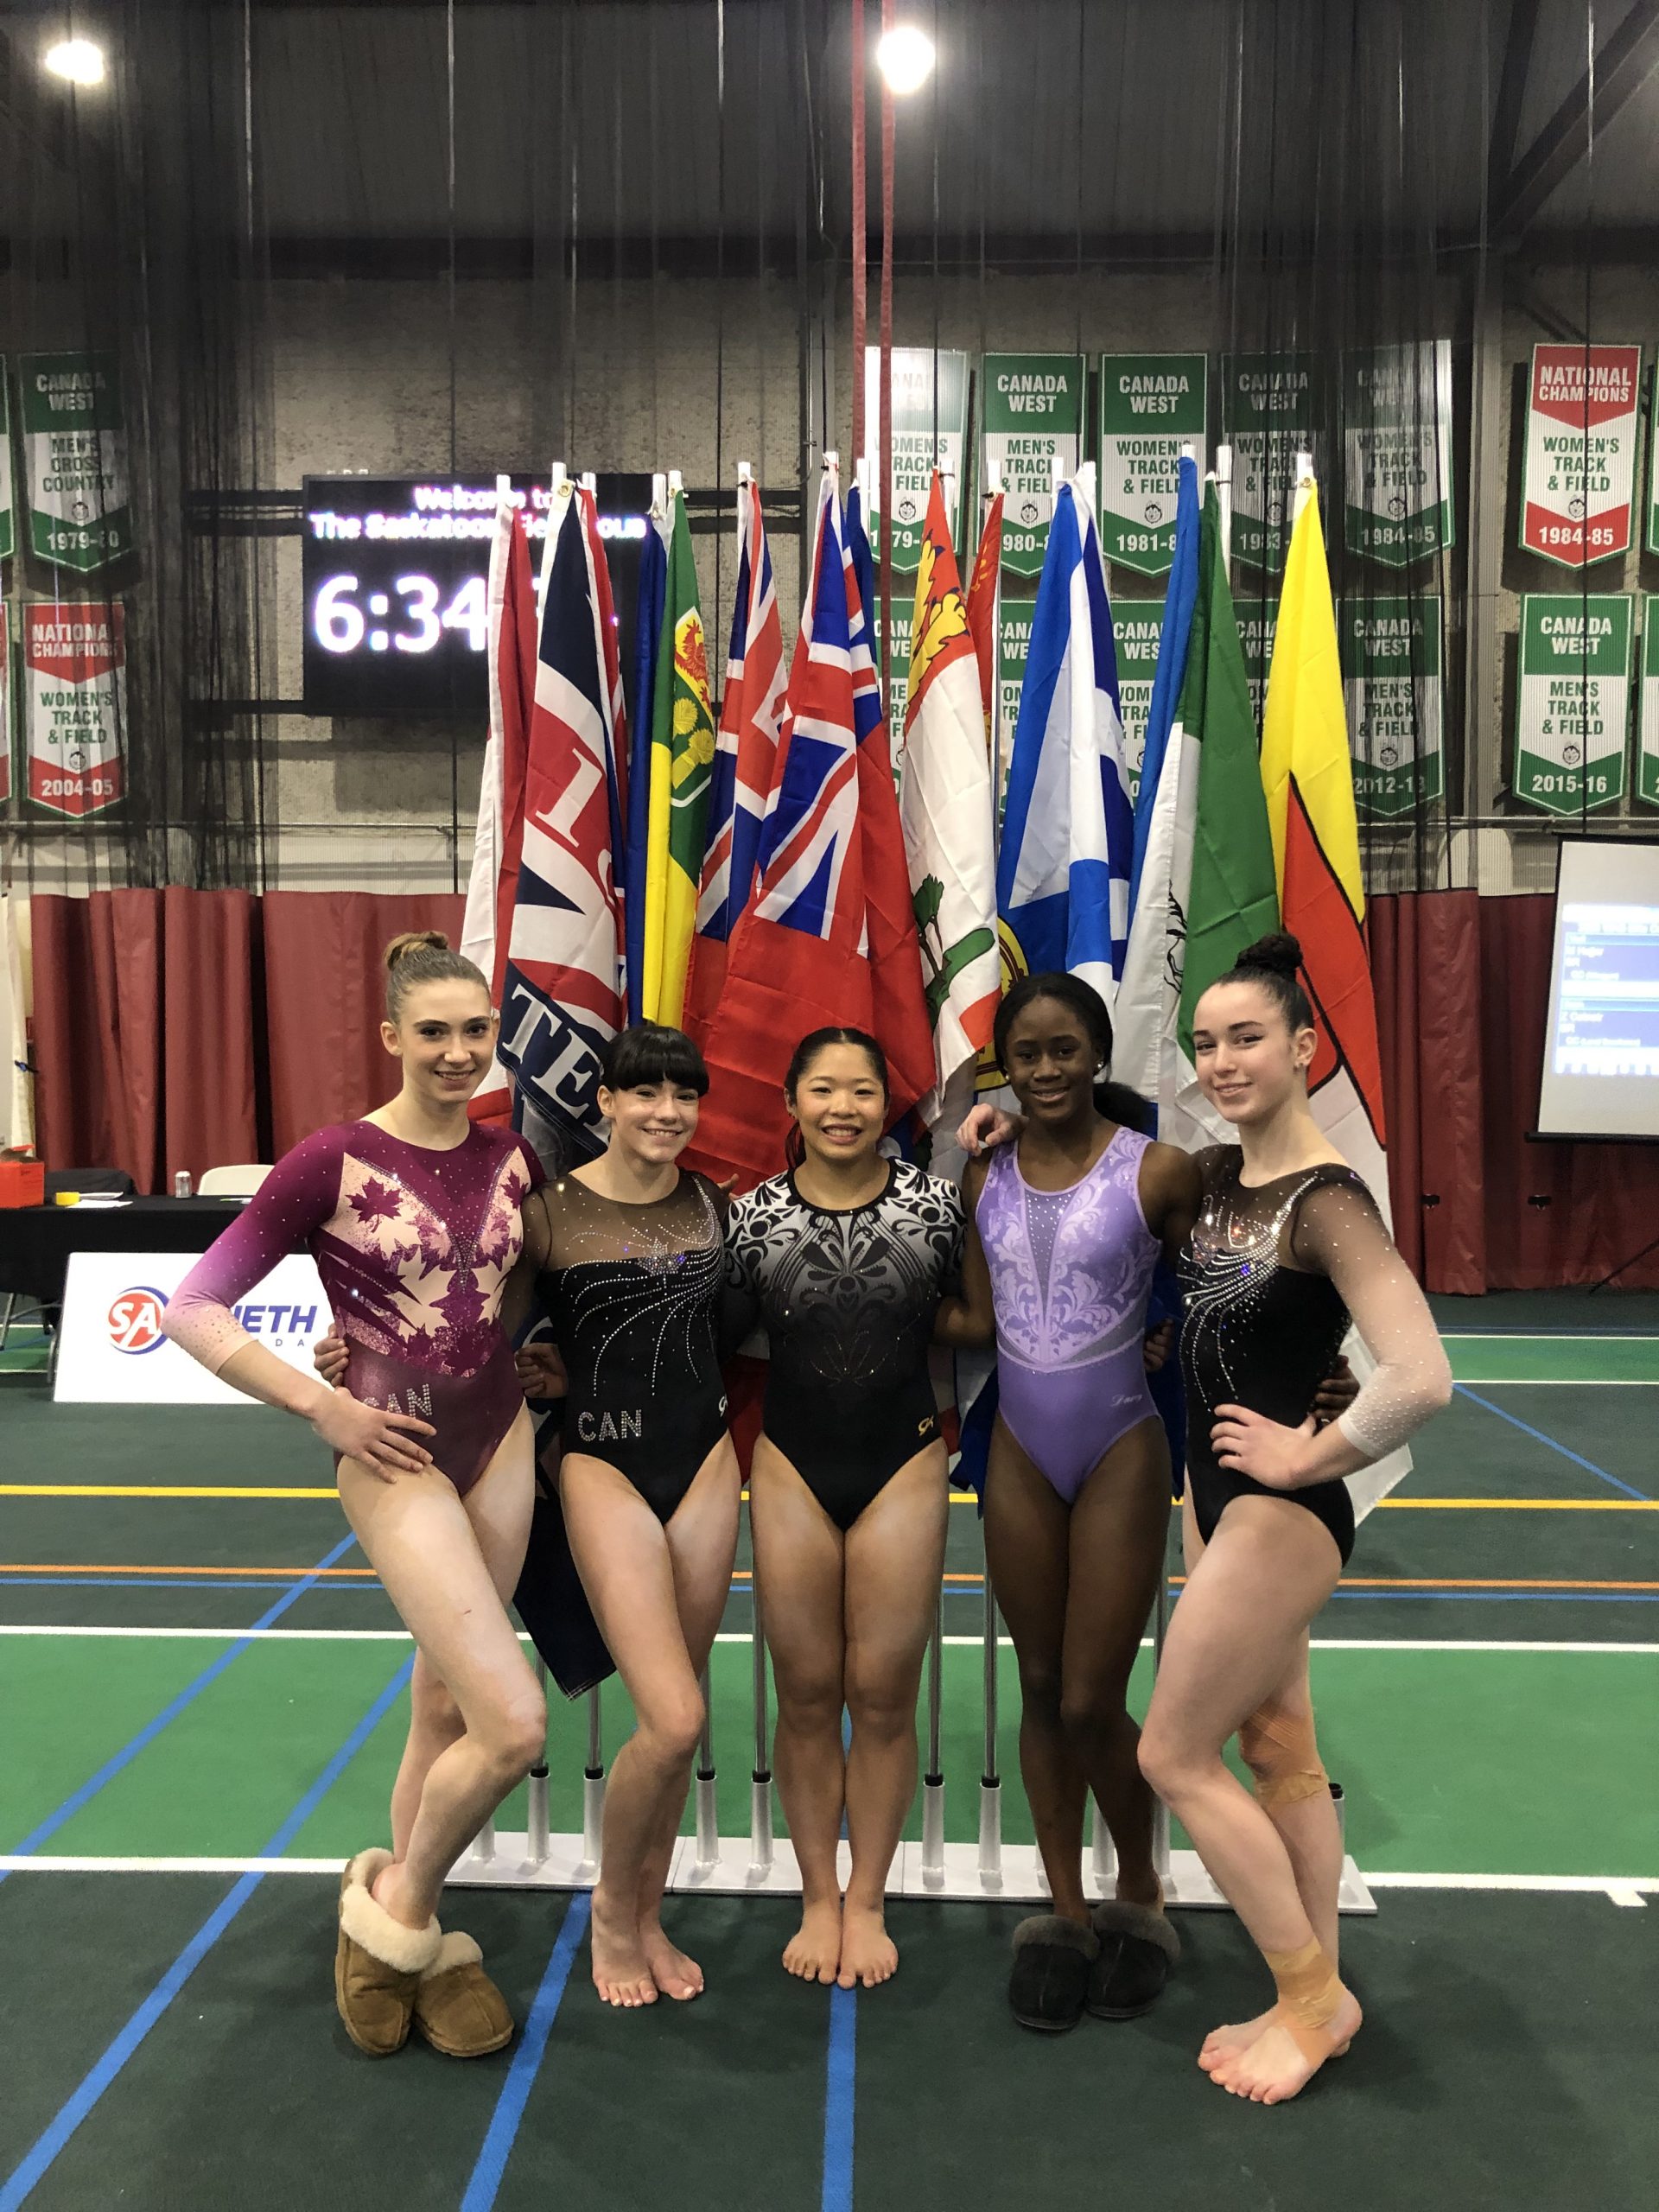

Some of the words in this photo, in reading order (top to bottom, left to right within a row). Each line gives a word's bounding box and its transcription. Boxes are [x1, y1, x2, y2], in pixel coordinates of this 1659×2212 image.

[997, 374, 1068, 393] CANADA
[1119, 375, 1190, 394] CANADA
[1541, 366, 1631, 386] NATIONAL
[1539, 385, 1629, 403] CHAMPIONS
[1008, 395, 1058, 413] WEST
[1130, 396, 1179, 414] WEST
[1007, 439, 1056, 455] MEN'S
[1116, 440, 1192, 456] WOMEN'
[1543, 437, 1619, 454] WOMEN'S
[893, 455, 937, 473] RACK
[1554, 456, 1606, 473] TRACK
[1001, 477, 1011, 493] &
[1017, 478, 1051, 493] FIEL
[1123, 479, 1135, 493] &
[1141, 479, 1179, 493] FIEL
[1245, 476, 1256, 493] &
[1548, 475, 1559, 491] &
[1565, 476, 1611, 493] FIELD
[310, 511, 362, 539] The
[1116, 534, 1177, 552] 1981-8
[1539, 525, 1613, 545] 1984-85
[315, 574, 488, 654] 6:34
[1114, 621, 1163, 639] CANA
[1352, 618, 1424, 638] CANADA
[1541, 616, 1612, 635] CANADA
[1124, 643, 1160, 660] WES
[1551, 636, 1601, 655] WEST
[1550, 681, 1599, 697] MEN'S
[41, 691, 113, 708] WOMEN'S
[1548, 700, 1601, 716] TRACK
[52, 710, 103, 726] TRACK
[1541, 719, 1553, 734] &
[1559, 720, 1605, 735] FIELD
[48, 728, 59, 744] &
[65, 728, 108, 744] FIELD
[41, 779, 113, 797] 2004-05
[1532, 774, 1607, 793] 2015-16
[578, 1408, 642, 1442] CAN
